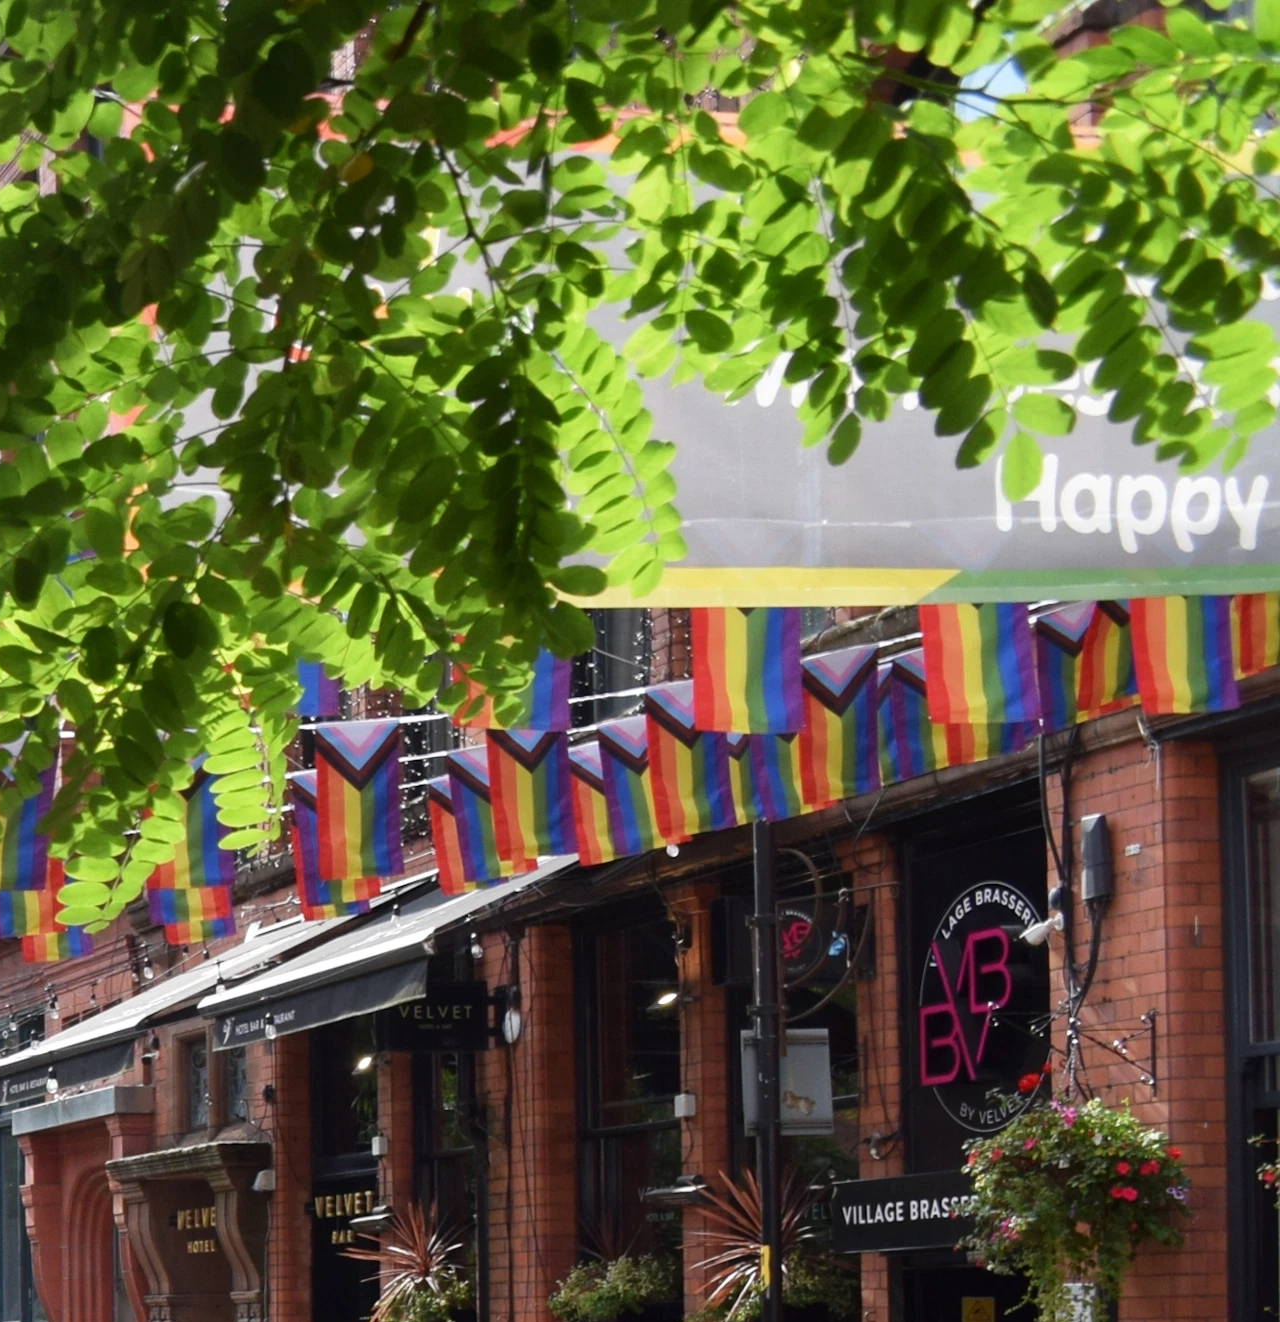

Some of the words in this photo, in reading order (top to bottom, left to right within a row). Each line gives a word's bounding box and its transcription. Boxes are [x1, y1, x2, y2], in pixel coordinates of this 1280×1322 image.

[994, 453, 1269, 554] Happy
[975, 888, 1037, 930] BRASSERI
[399, 1004, 473, 1020] VELVET
[959, 1102, 976, 1121] BY
[978, 1097, 1018, 1125] VELVE
[314, 1190, 375, 1218] VELVET
[842, 1201, 905, 1226] VILLAGE
[176, 1206, 216, 1231] VELVE
[186, 1239, 217, 1254] HOTEL
[331, 1230, 357, 1245] BAR
